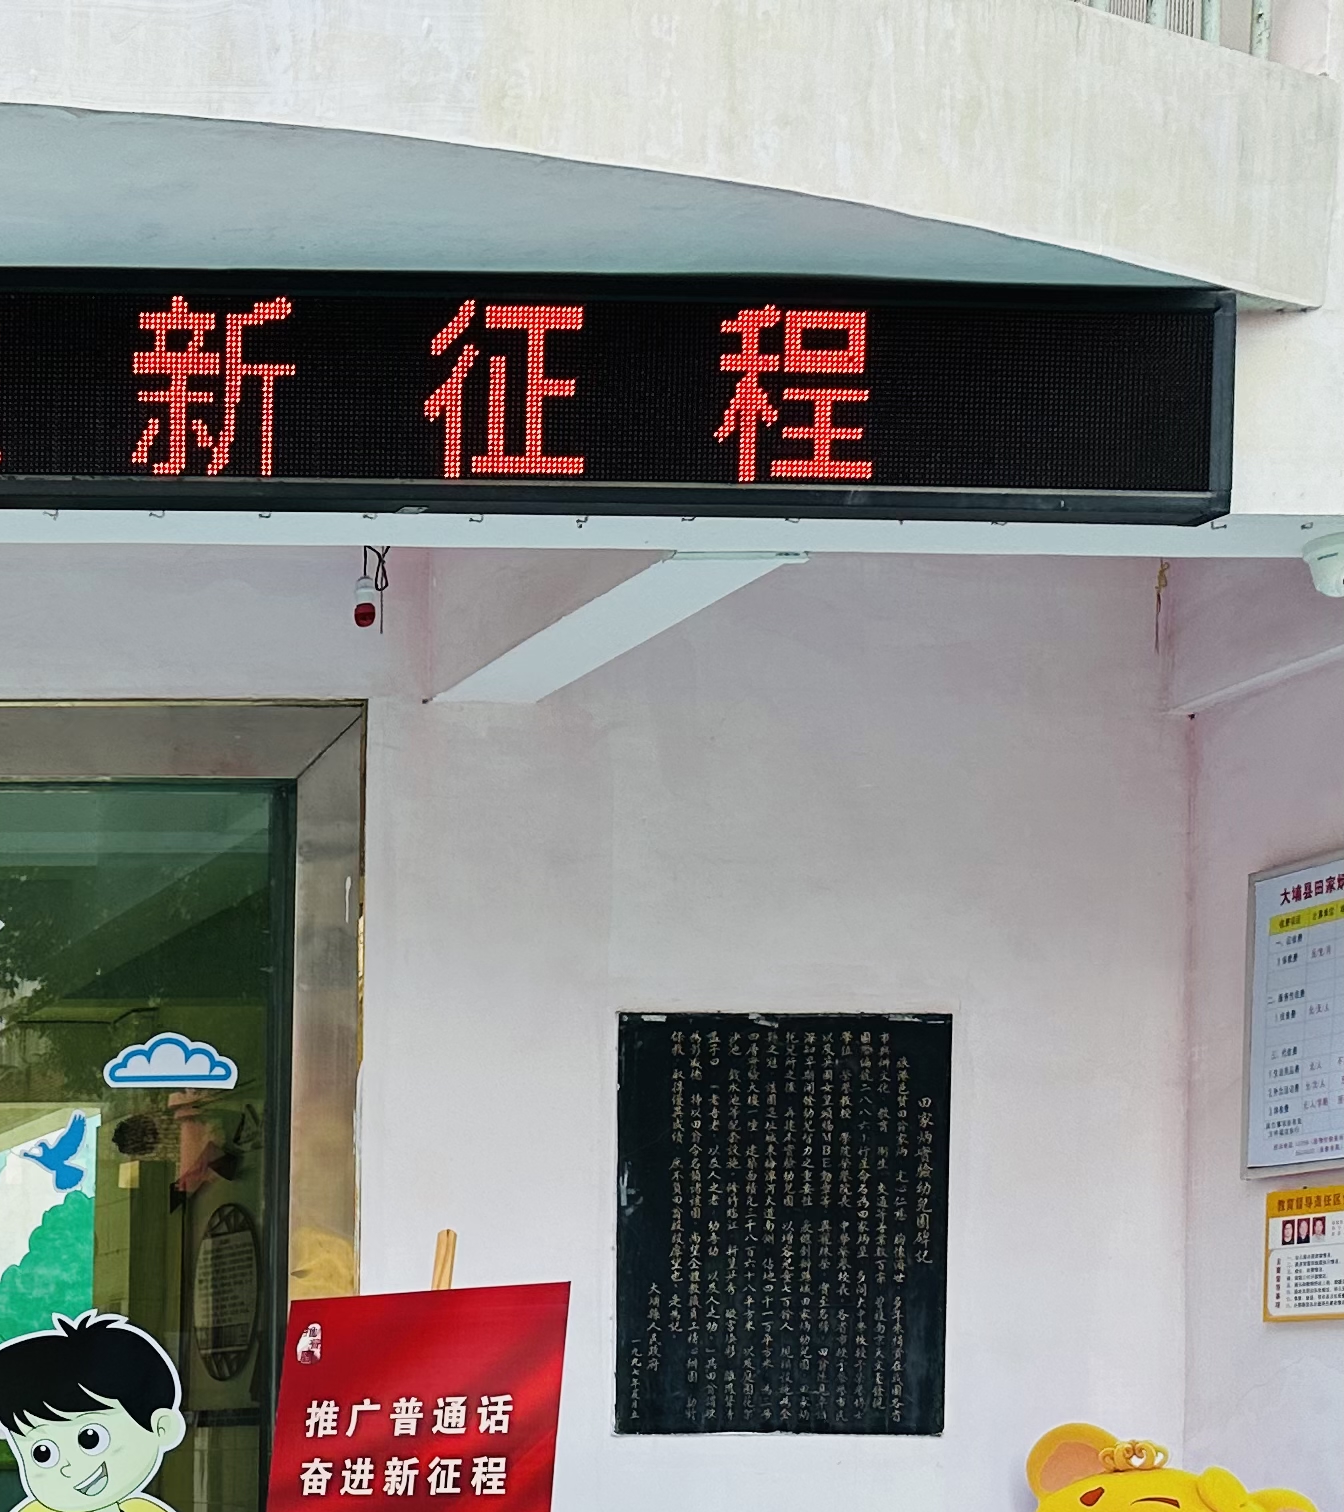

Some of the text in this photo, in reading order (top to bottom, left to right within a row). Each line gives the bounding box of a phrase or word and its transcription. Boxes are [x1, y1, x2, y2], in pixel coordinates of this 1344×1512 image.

[305, 1394, 515, 1439] 推广普通话
[299, 1456, 509, 1497] 奋进新征程
